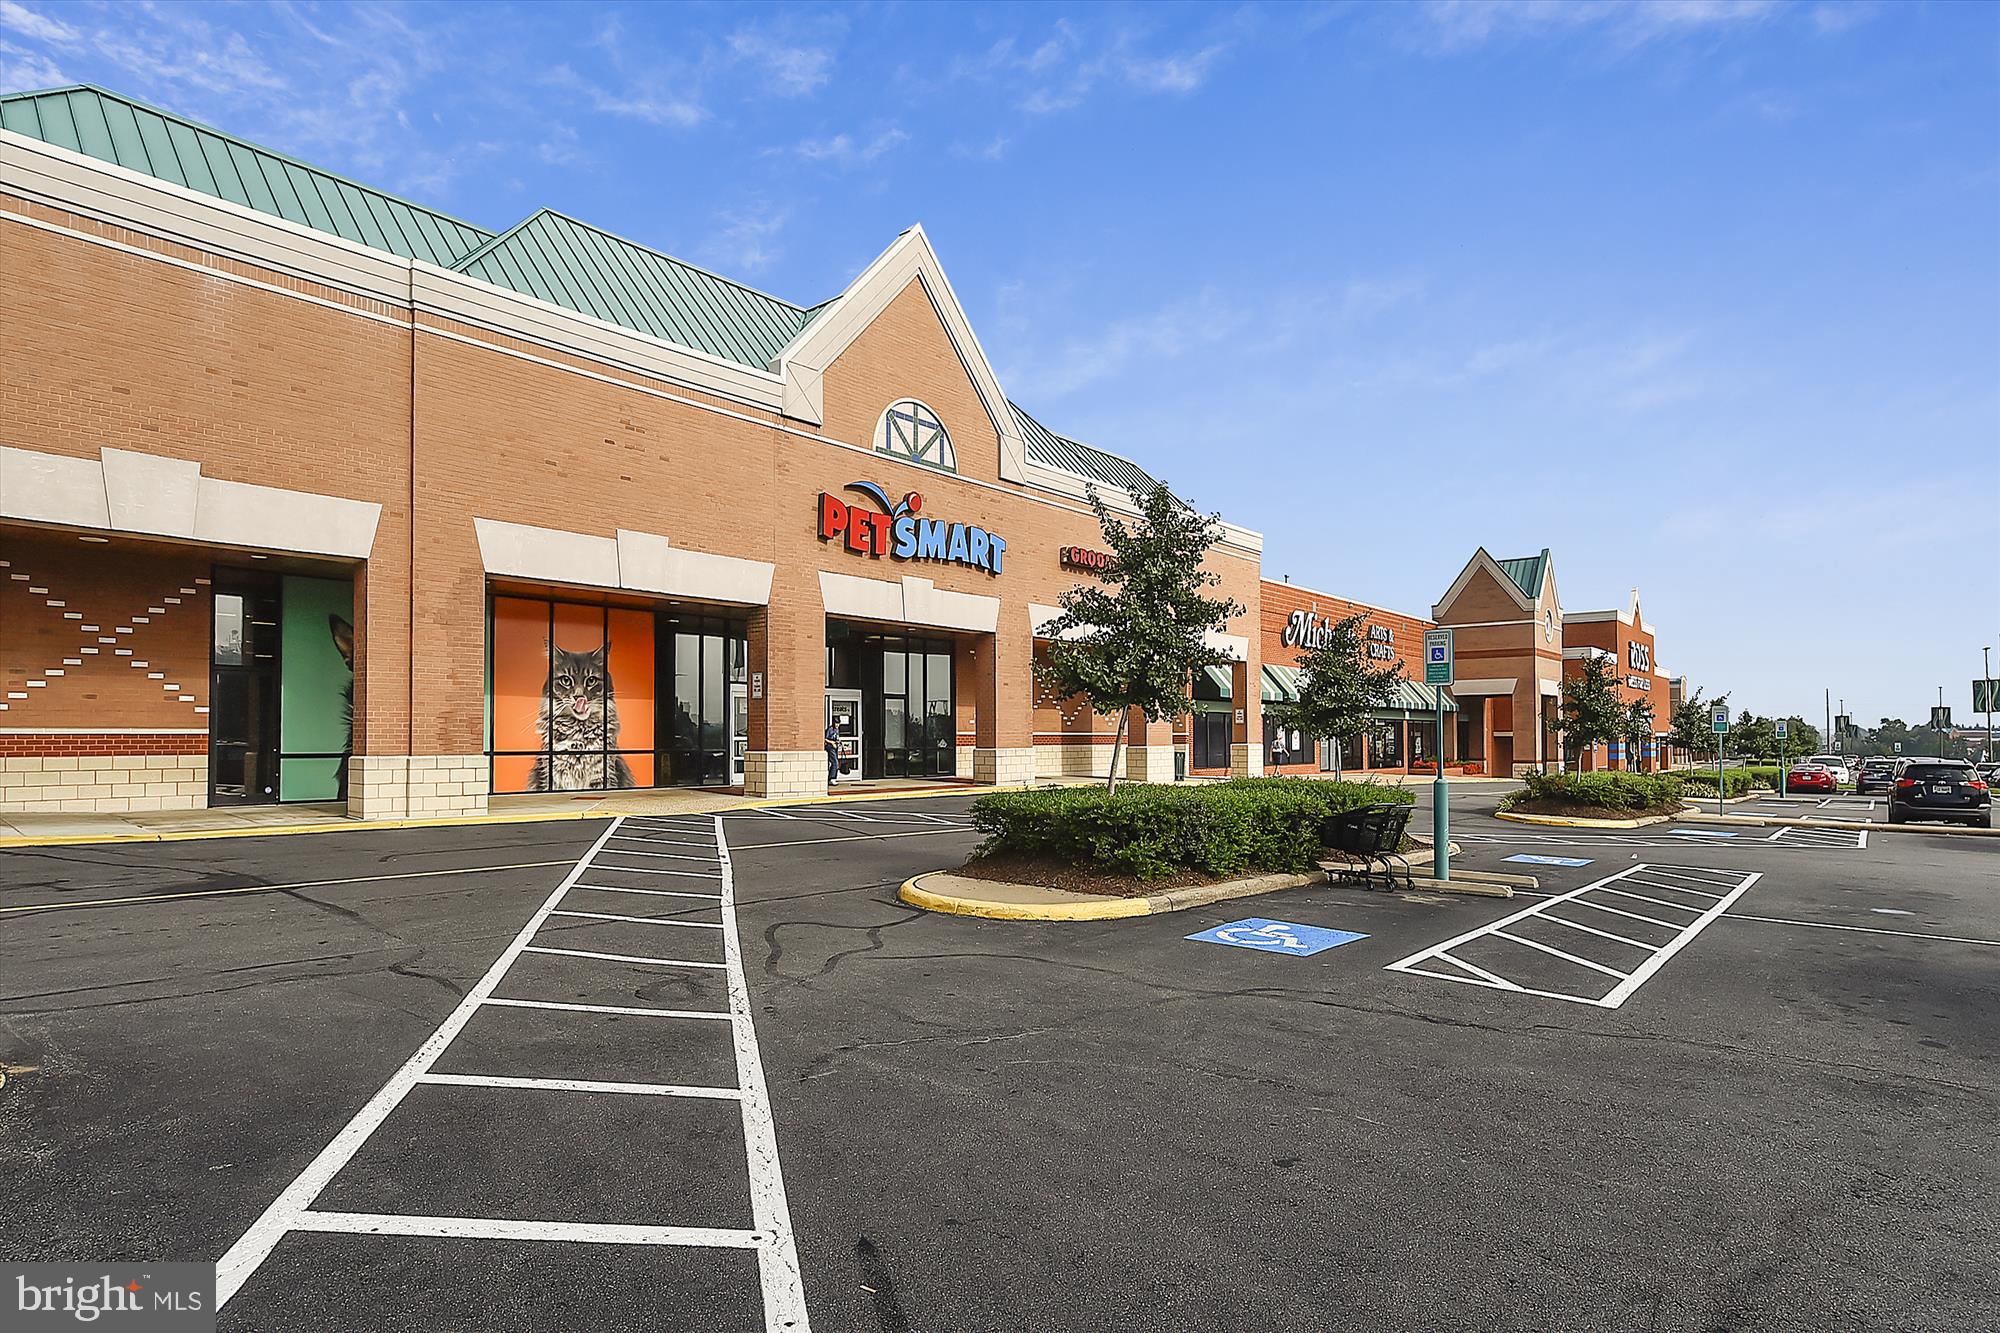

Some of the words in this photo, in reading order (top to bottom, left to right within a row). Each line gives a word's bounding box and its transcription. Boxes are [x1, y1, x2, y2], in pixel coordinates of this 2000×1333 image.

[818, 490, 1006, 575] PETSMART
[1283, 609, 1355, 650] Mich
[1370, 624, 1388, 641] ARTS
[1387, 628, 1395, 643] &
[1369, 643, 1395, 660] CRAFTS
[1630, 640, 1650, 672] ROSS
